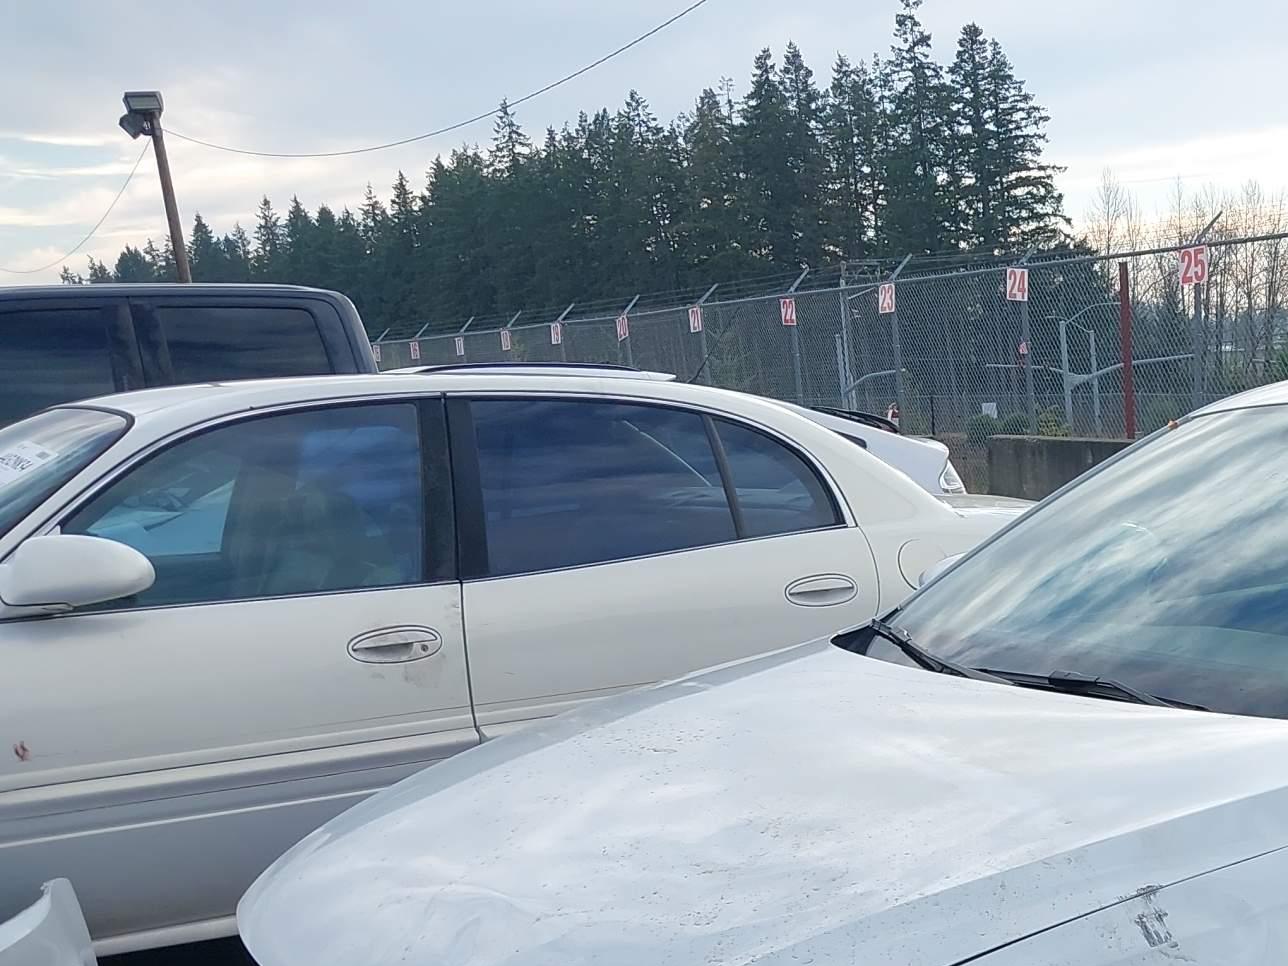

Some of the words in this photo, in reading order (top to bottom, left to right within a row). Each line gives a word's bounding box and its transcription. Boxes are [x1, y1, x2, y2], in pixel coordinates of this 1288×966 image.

[1180, 247, 1206, 284] 25
[1007, 269, 1027, 300] 24
[782, 299, 795, 324] 22
[879, 285, 894, 312] 23
[617, 316, 629, 339] 20
[690, 308, 702, 331] 21
